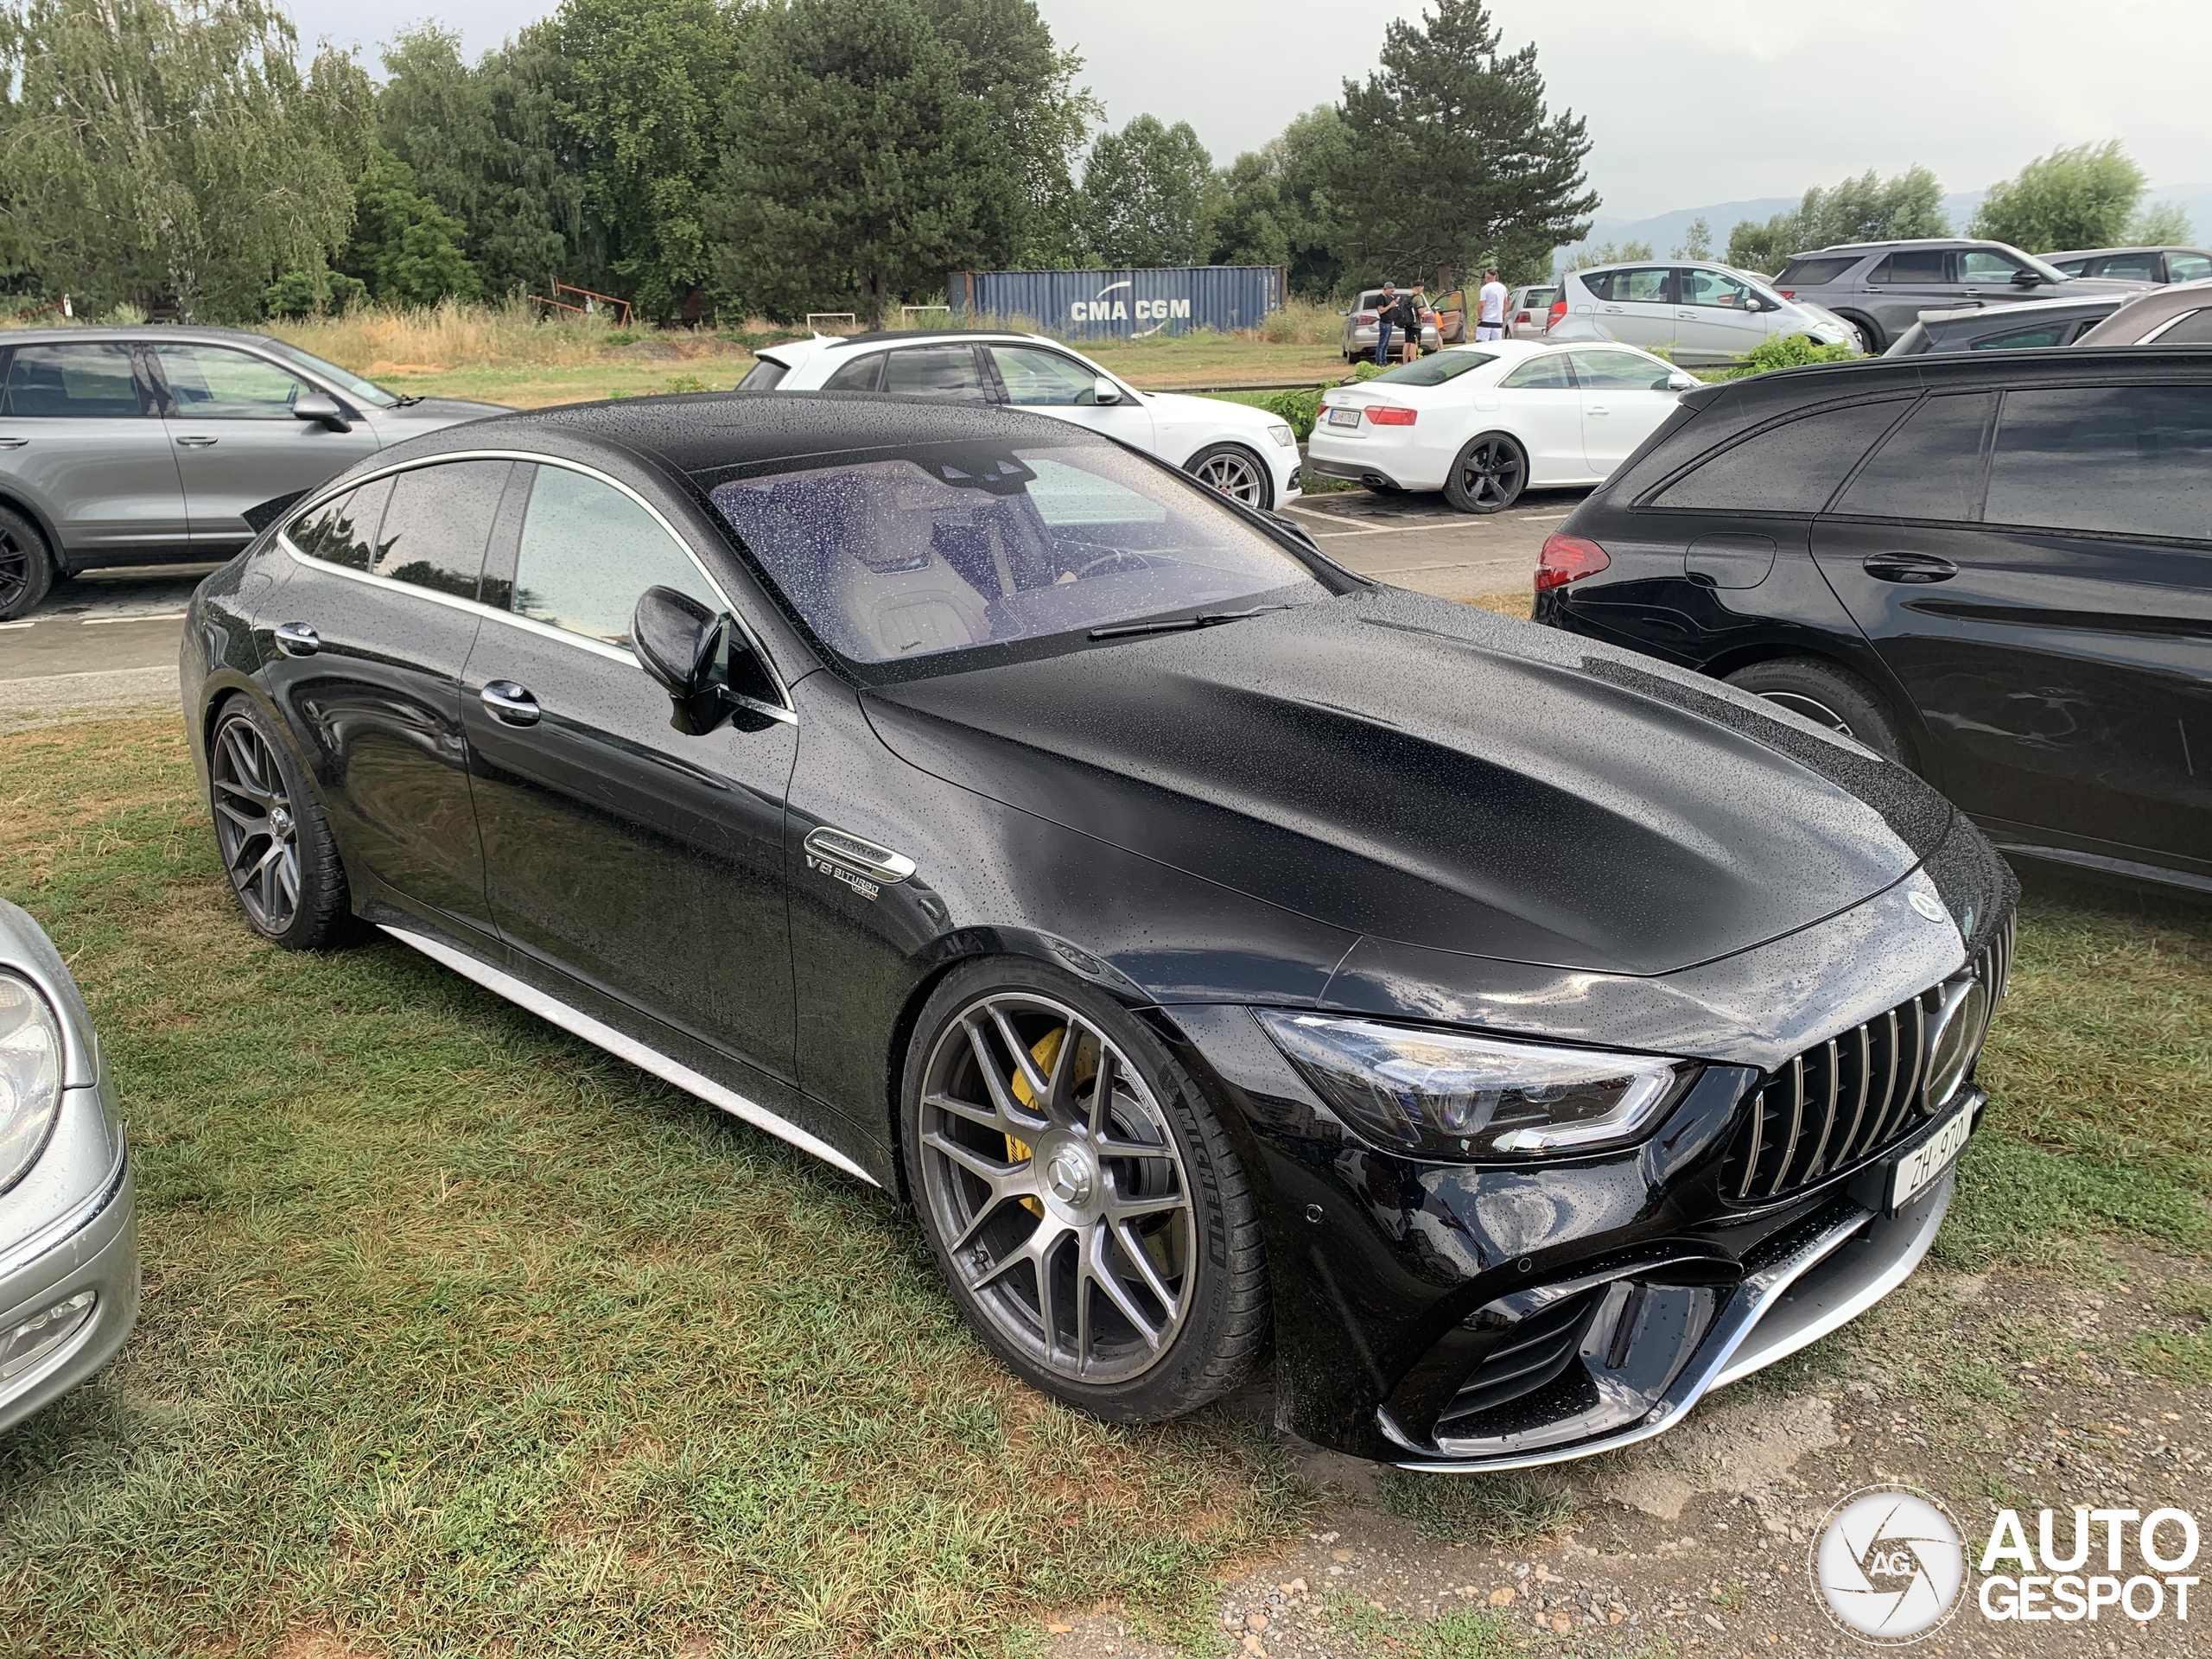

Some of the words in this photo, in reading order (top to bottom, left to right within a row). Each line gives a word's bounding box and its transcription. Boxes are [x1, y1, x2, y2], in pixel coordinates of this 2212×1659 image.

[1071, 301, 1128, 321] CMA
[1135, 299, 1190, 319] CGM
[805, 855, 833, 876] V8
[834, 868, 880, 894] BITURBO
[1178, 1106, 1227, 1262] MICHELIN
[1211, 1277, 1224, 1315] PILOT
[1197, 1317, 1216, 1357] SPORT
